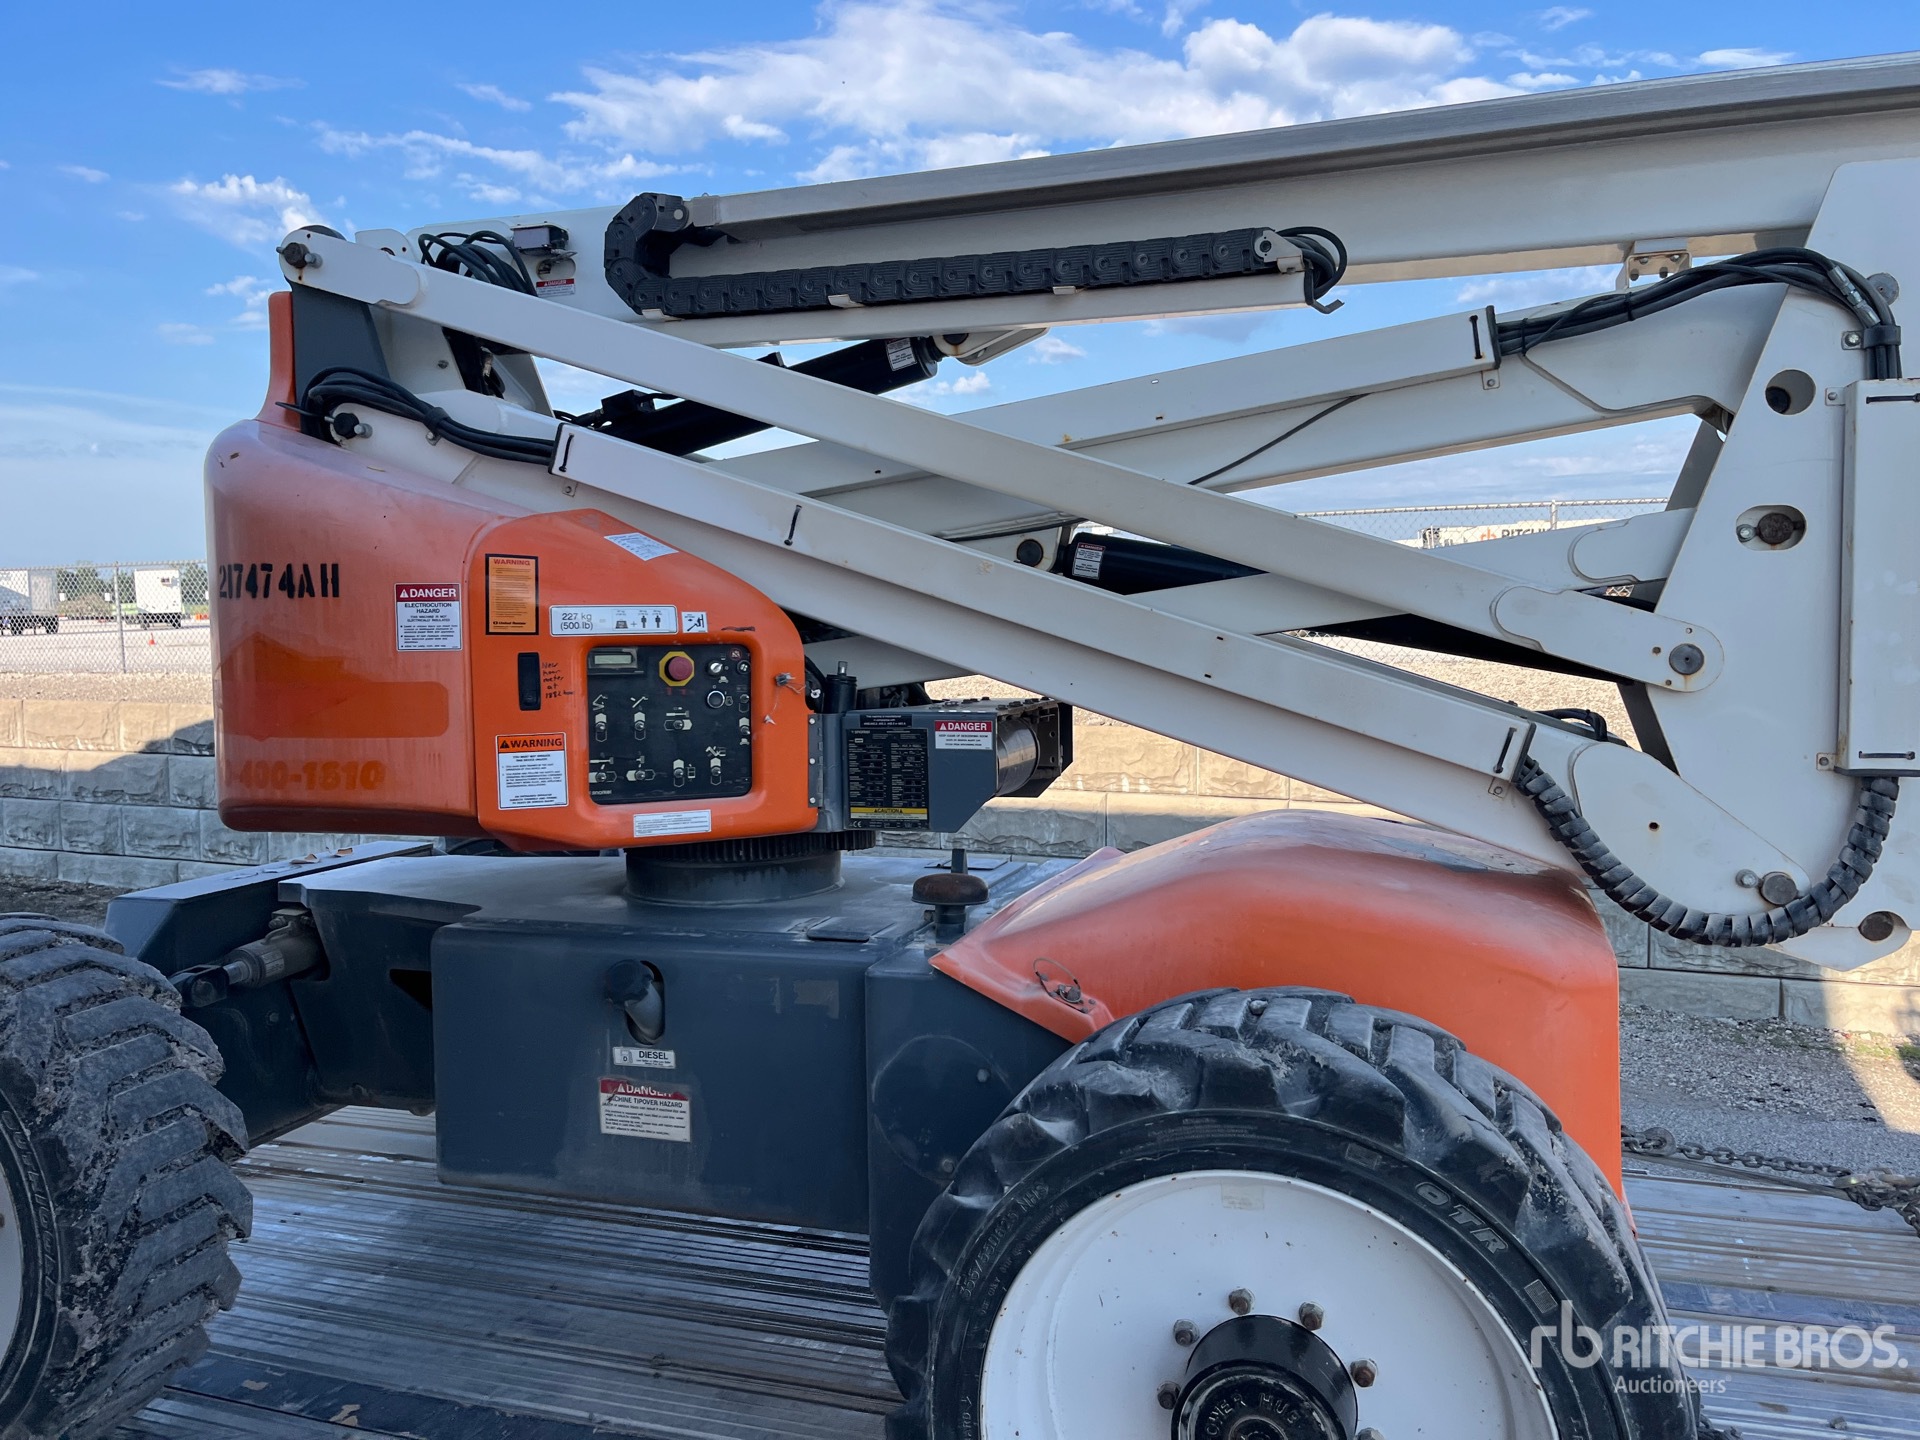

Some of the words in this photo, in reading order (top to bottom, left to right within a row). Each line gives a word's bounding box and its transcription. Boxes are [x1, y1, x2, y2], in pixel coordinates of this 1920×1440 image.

[410, 588, 456, 598] DANGER
[561, 612, 578, 620] 227
[581, 612, 592, 622] kg
[560, 621, 580, 630] (500
[581, 621, 593, 631] lb)
[948, 722, 987, 731] DANGER
[511, 738, 562, 748] WARNING
[639, 1050, 669, 1060] DIESEL
[634, 1098, 658, 1107] TIPOVER
[660, 1100, 683, 1109] HAZARD
[1414, 1181, 1509, 1254] OTR
